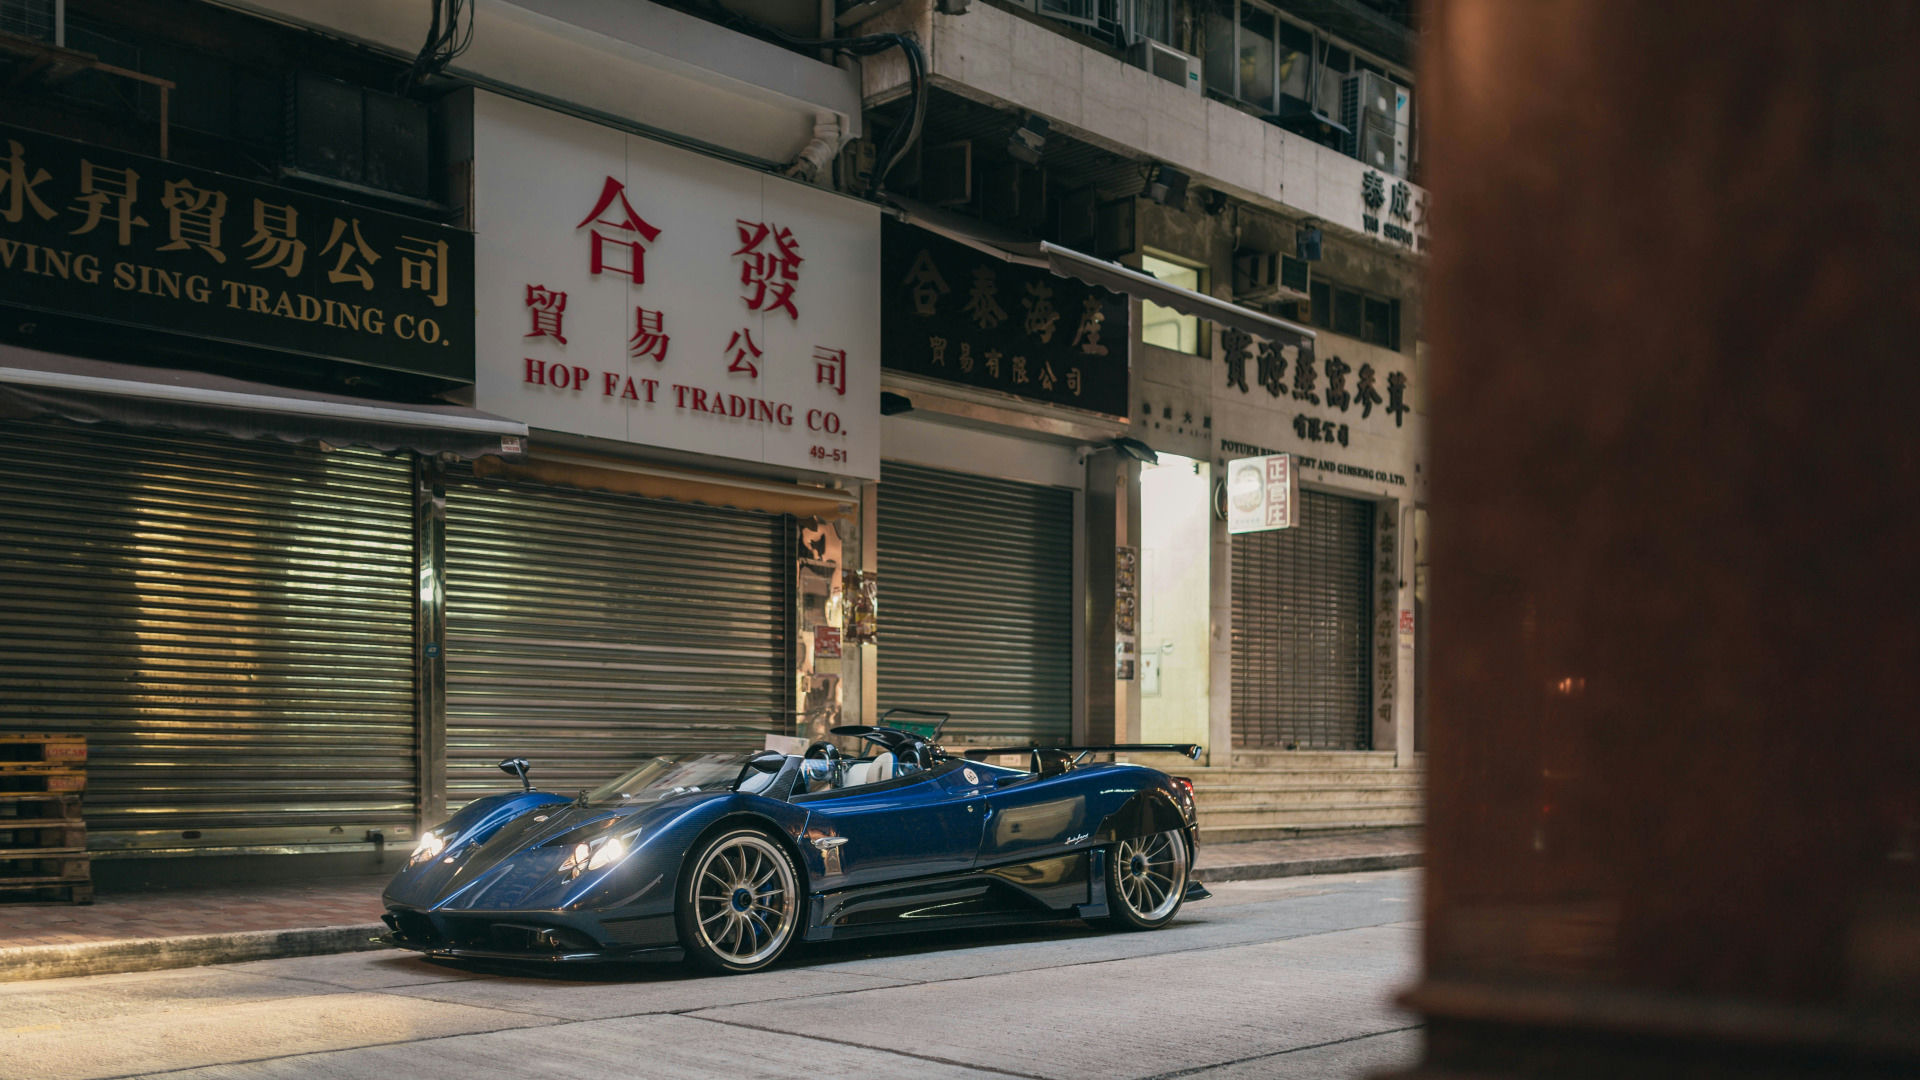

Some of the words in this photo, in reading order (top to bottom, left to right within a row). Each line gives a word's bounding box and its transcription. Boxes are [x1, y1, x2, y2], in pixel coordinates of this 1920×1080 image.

[0, 139, 449, 307] 永昇貿易公司
[576, 175, 805, 320] 合發
[113, 262, 212, 304] SING
[222, 279, 387, 335] TRADING
[393, 313, 450, 347] CO.
[524, 284, 847, 396] 貿易公司
[524, 358, 590, 391] HOP
[602, 371, 660, 403] FAT
[672, 384, 794, 427] TRADING
[806, 408, 848, 437] CO.
[929, 335, 1082, 397] 貿易有限公司
[1293, 414, 1349, 448] 有限公司
[1318, 458, 1336, 473] AND
[1337, 461, 1374, 480] GINSENG
[1267, 460, 1287, 525] 正官庄
